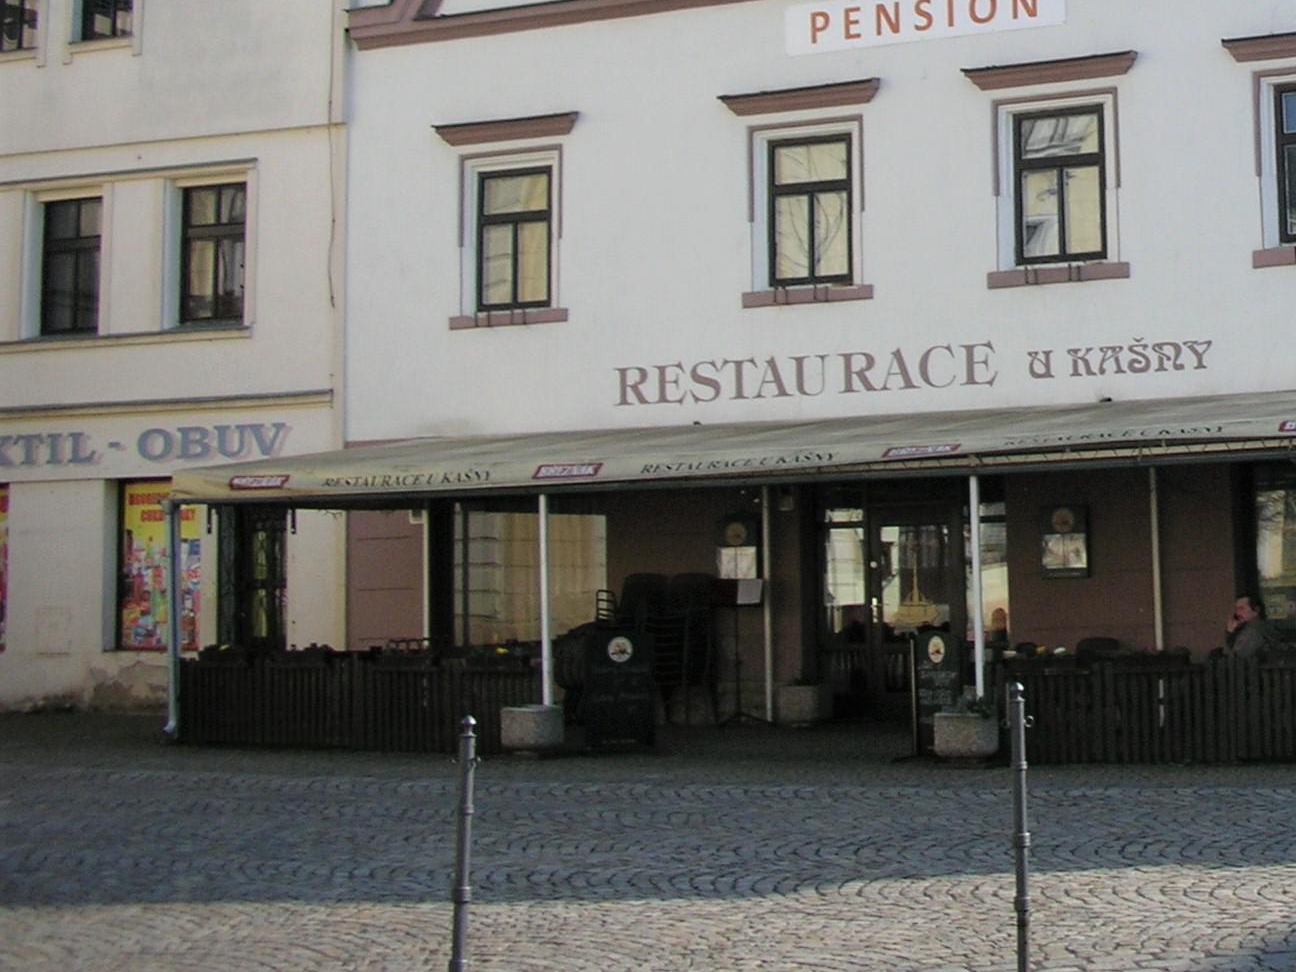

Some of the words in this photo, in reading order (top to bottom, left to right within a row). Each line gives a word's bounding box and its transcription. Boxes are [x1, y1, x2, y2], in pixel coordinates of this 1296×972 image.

[614, 340, 999, 406] RESTAURACE
[1068, 337, 1213, 377] KAŠNY
[137, 422, 287, 462] OBUV
